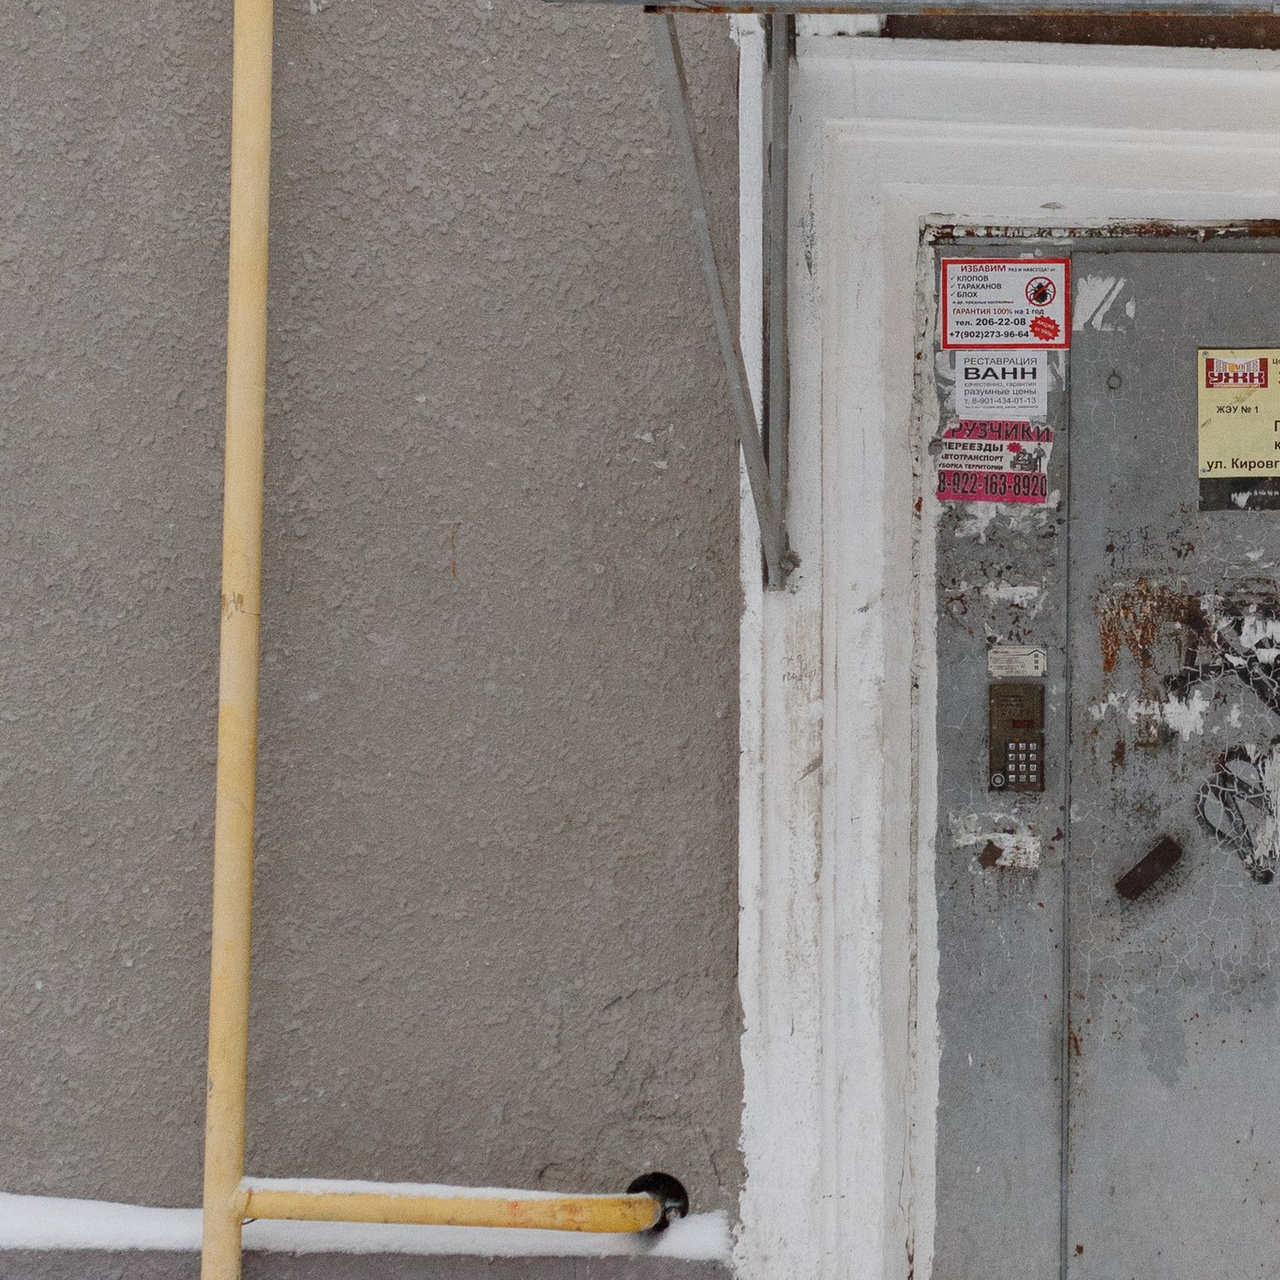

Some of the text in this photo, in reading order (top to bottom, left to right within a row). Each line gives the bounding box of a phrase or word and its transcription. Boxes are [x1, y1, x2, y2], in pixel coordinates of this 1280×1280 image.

[975, 318, 1026, 326] 206-22-08
[949, 330, 1029, 339] +7(902)273-96-64
[964, 357, 1038, 366] РЕСТАВРАЦИЯ
[964, 367, 1037, 380] ВАНН
[1209, 372, 1264, 384] УЖК
[971, 397, 1037, 405] 8-901-434-01-13
[1216, 405, 1259, 414] ЖЭУ № 1
[951, 421, 1051, 442] РУЗЧИКИ
[1207, 460, 1227, 472] ул.
